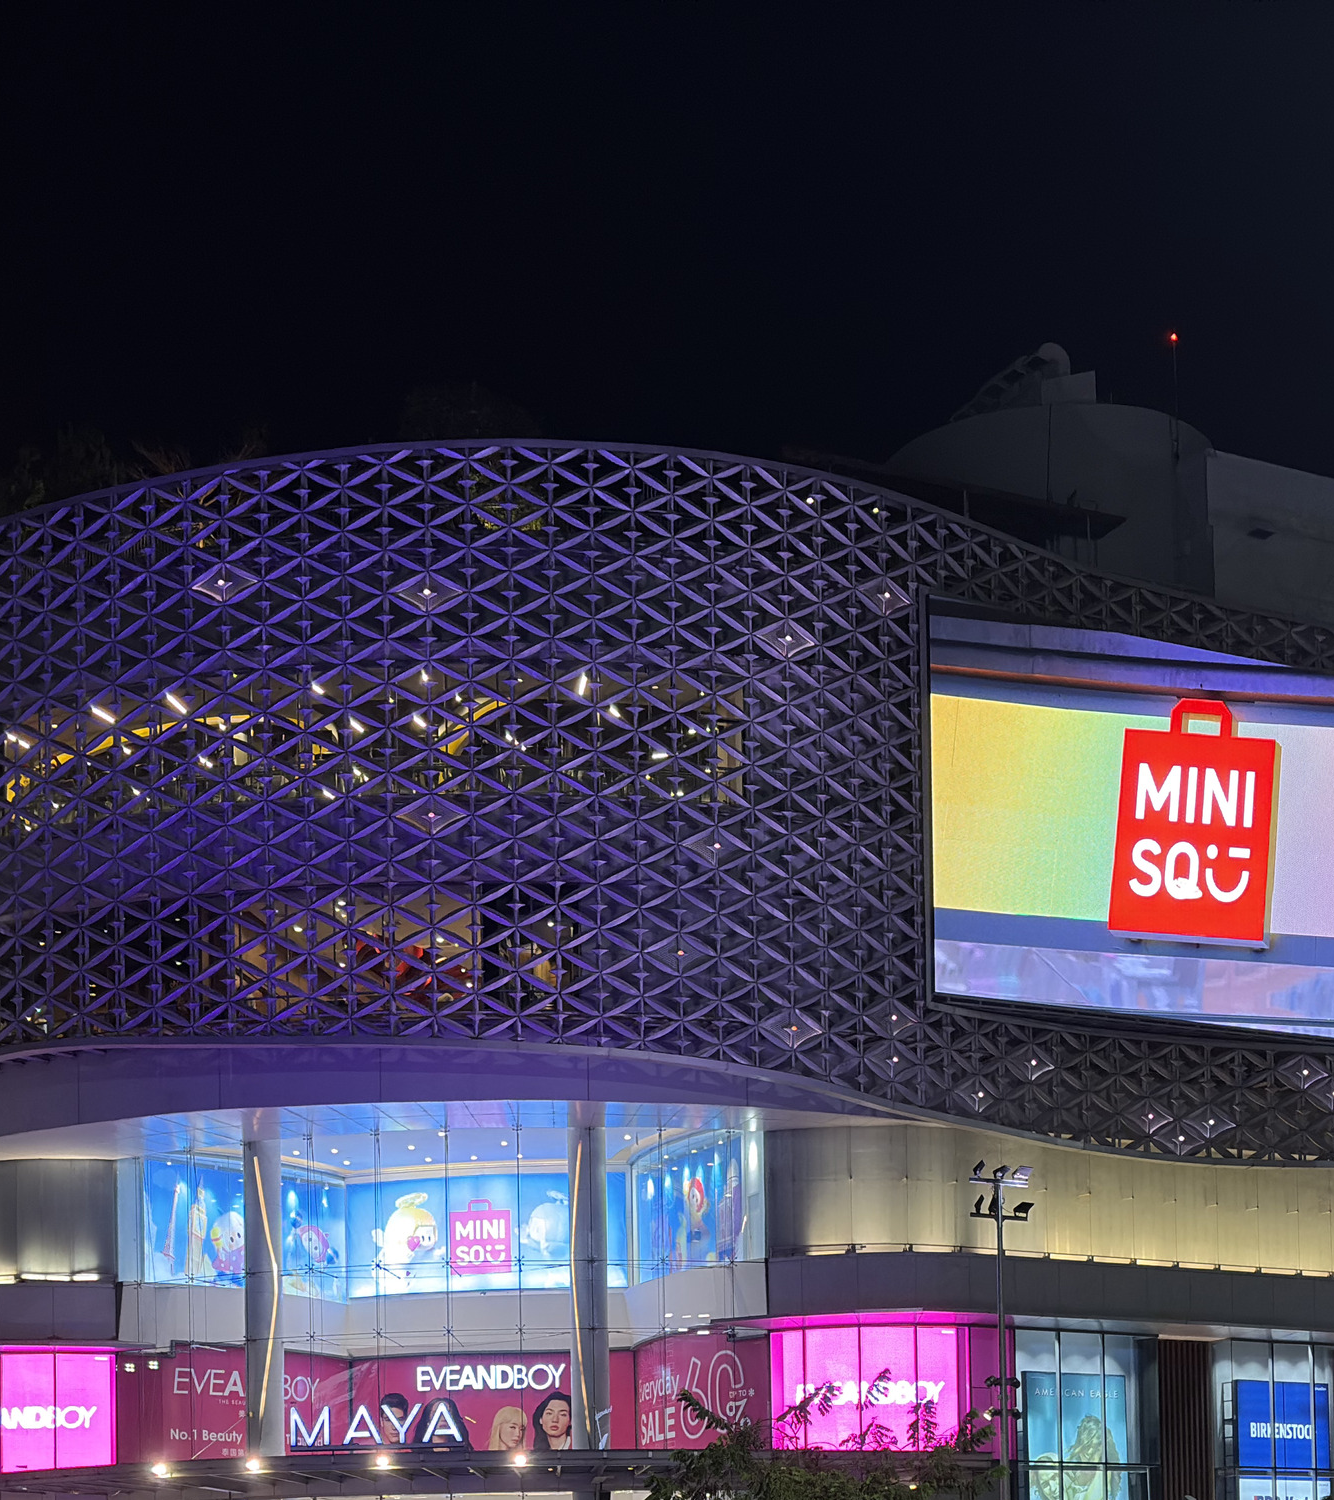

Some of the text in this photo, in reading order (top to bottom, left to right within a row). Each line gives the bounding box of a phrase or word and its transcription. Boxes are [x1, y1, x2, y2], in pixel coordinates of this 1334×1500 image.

[1135, 762, 1256, 828] MINI
[455, 1218, 506, 1241] MINI
[417, 1364, 565, 1392] EVEANDBOY
[638, 1373, 679, 1404] Everyday
[1034, 1387, 1119, 1399] AMECAN EALE
[170, 1428, 243, 1445] No.1 Beauty
[291, 1402, 463, 1447] MAYA
[640, 1406, 676, 1445] SALE
